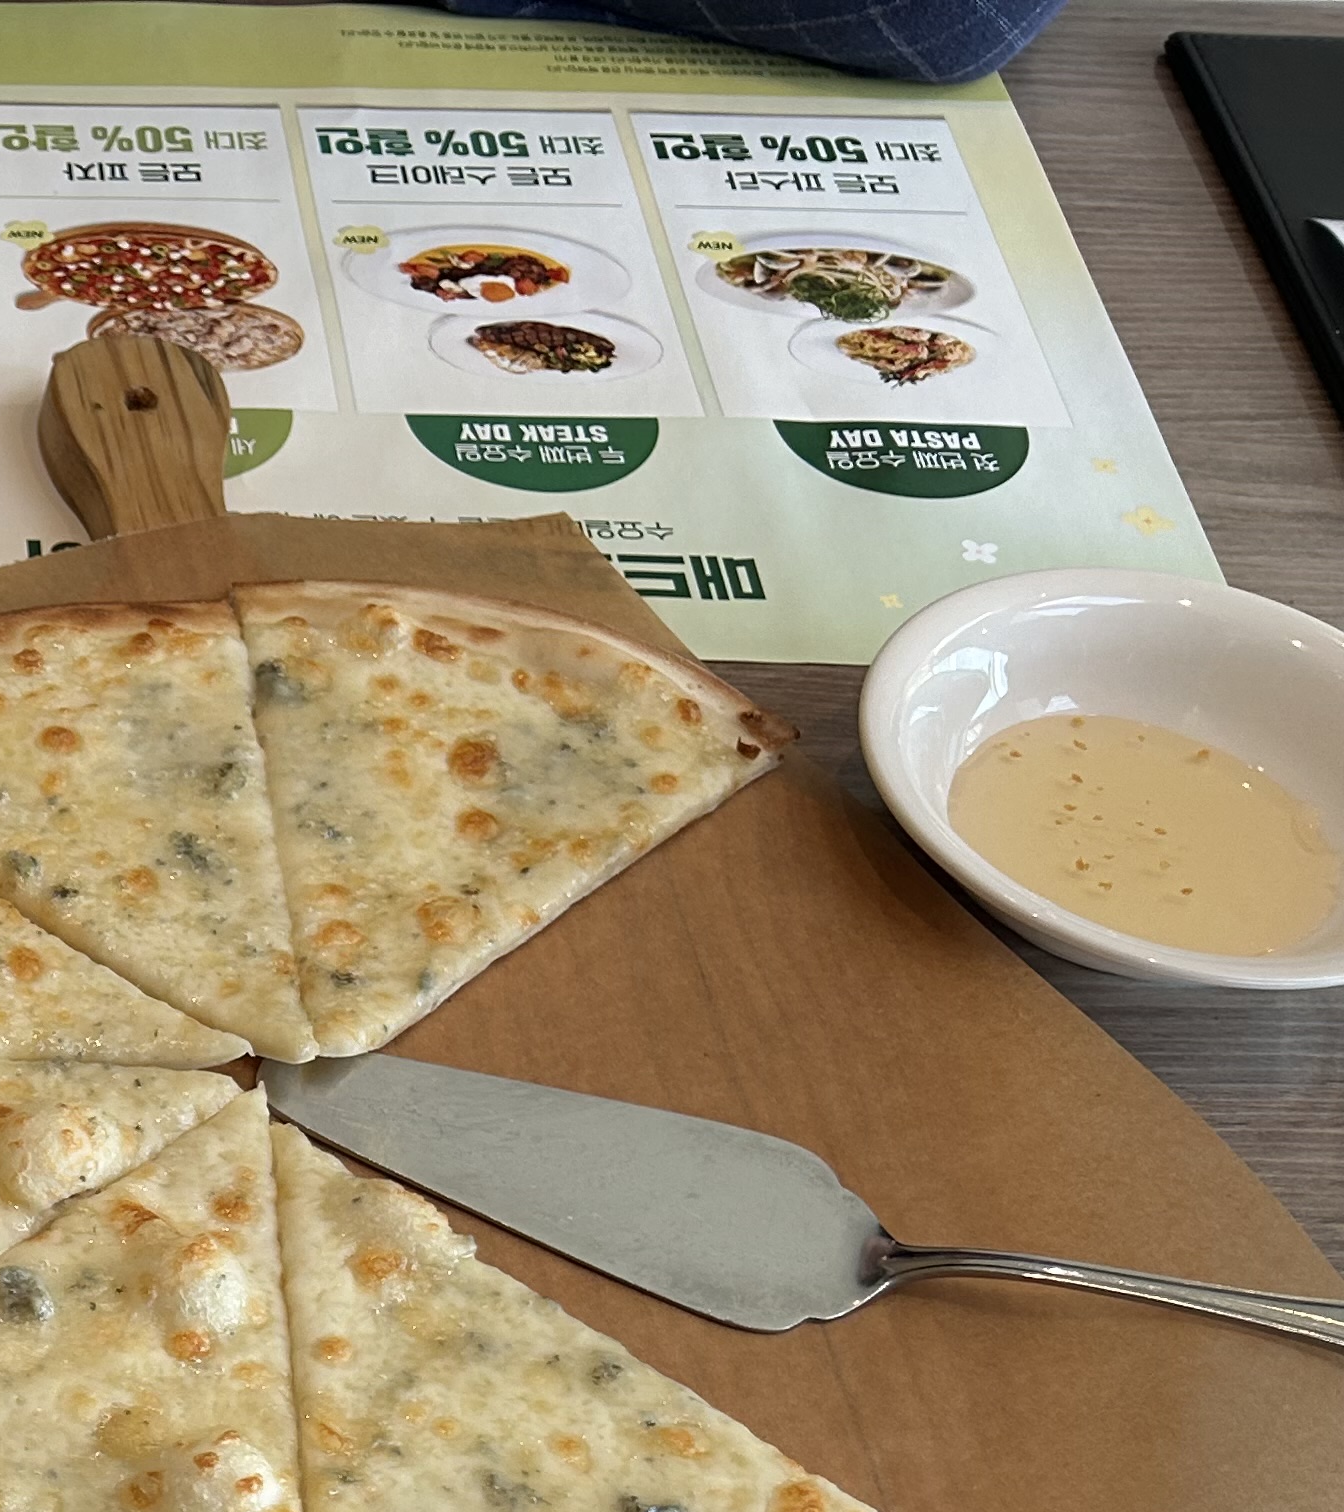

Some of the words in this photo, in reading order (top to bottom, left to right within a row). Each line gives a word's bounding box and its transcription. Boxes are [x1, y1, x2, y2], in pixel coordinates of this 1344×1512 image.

[90, 125, 195, 152] 50%
[205, 130, 268, 150] 최대
[315, 127, 414, 155] 할인
[424, 129, 529, 157] 50%
[539, 135, 604, 155] 최대
[649, 133, 753, 160] 할인
[760, 135, 868, 163] 50%
[875, 141, 942, 162] 최대
[63, 162, 129, 182] 피자
[139, 162, 202, 182] 모든
[366, 165, 496, 185] 스테이크
[507, 166, 572, 186] 모든
[725, 170, 825, 191] 파스타
[833, 172, 899, 194] 모든
[342, 235, 379, 244] NEW
[698, 240, 733, 250] NEW
[459, 423, 511, 441] DAY
[519, 424, 608, 442] STEAK
[830, 430, 884, 447] DAY
[890, 429, 980, 450] PASTA
[455, 443, 533, 462] 수요일
[539, 444, 593, 464] 번째
[598, 446, 624, 464] 두
[825, 451, 906, 470] 수요일
[914, 451, 967, 470] 번째
[973, 453, 999, 472] 첫
